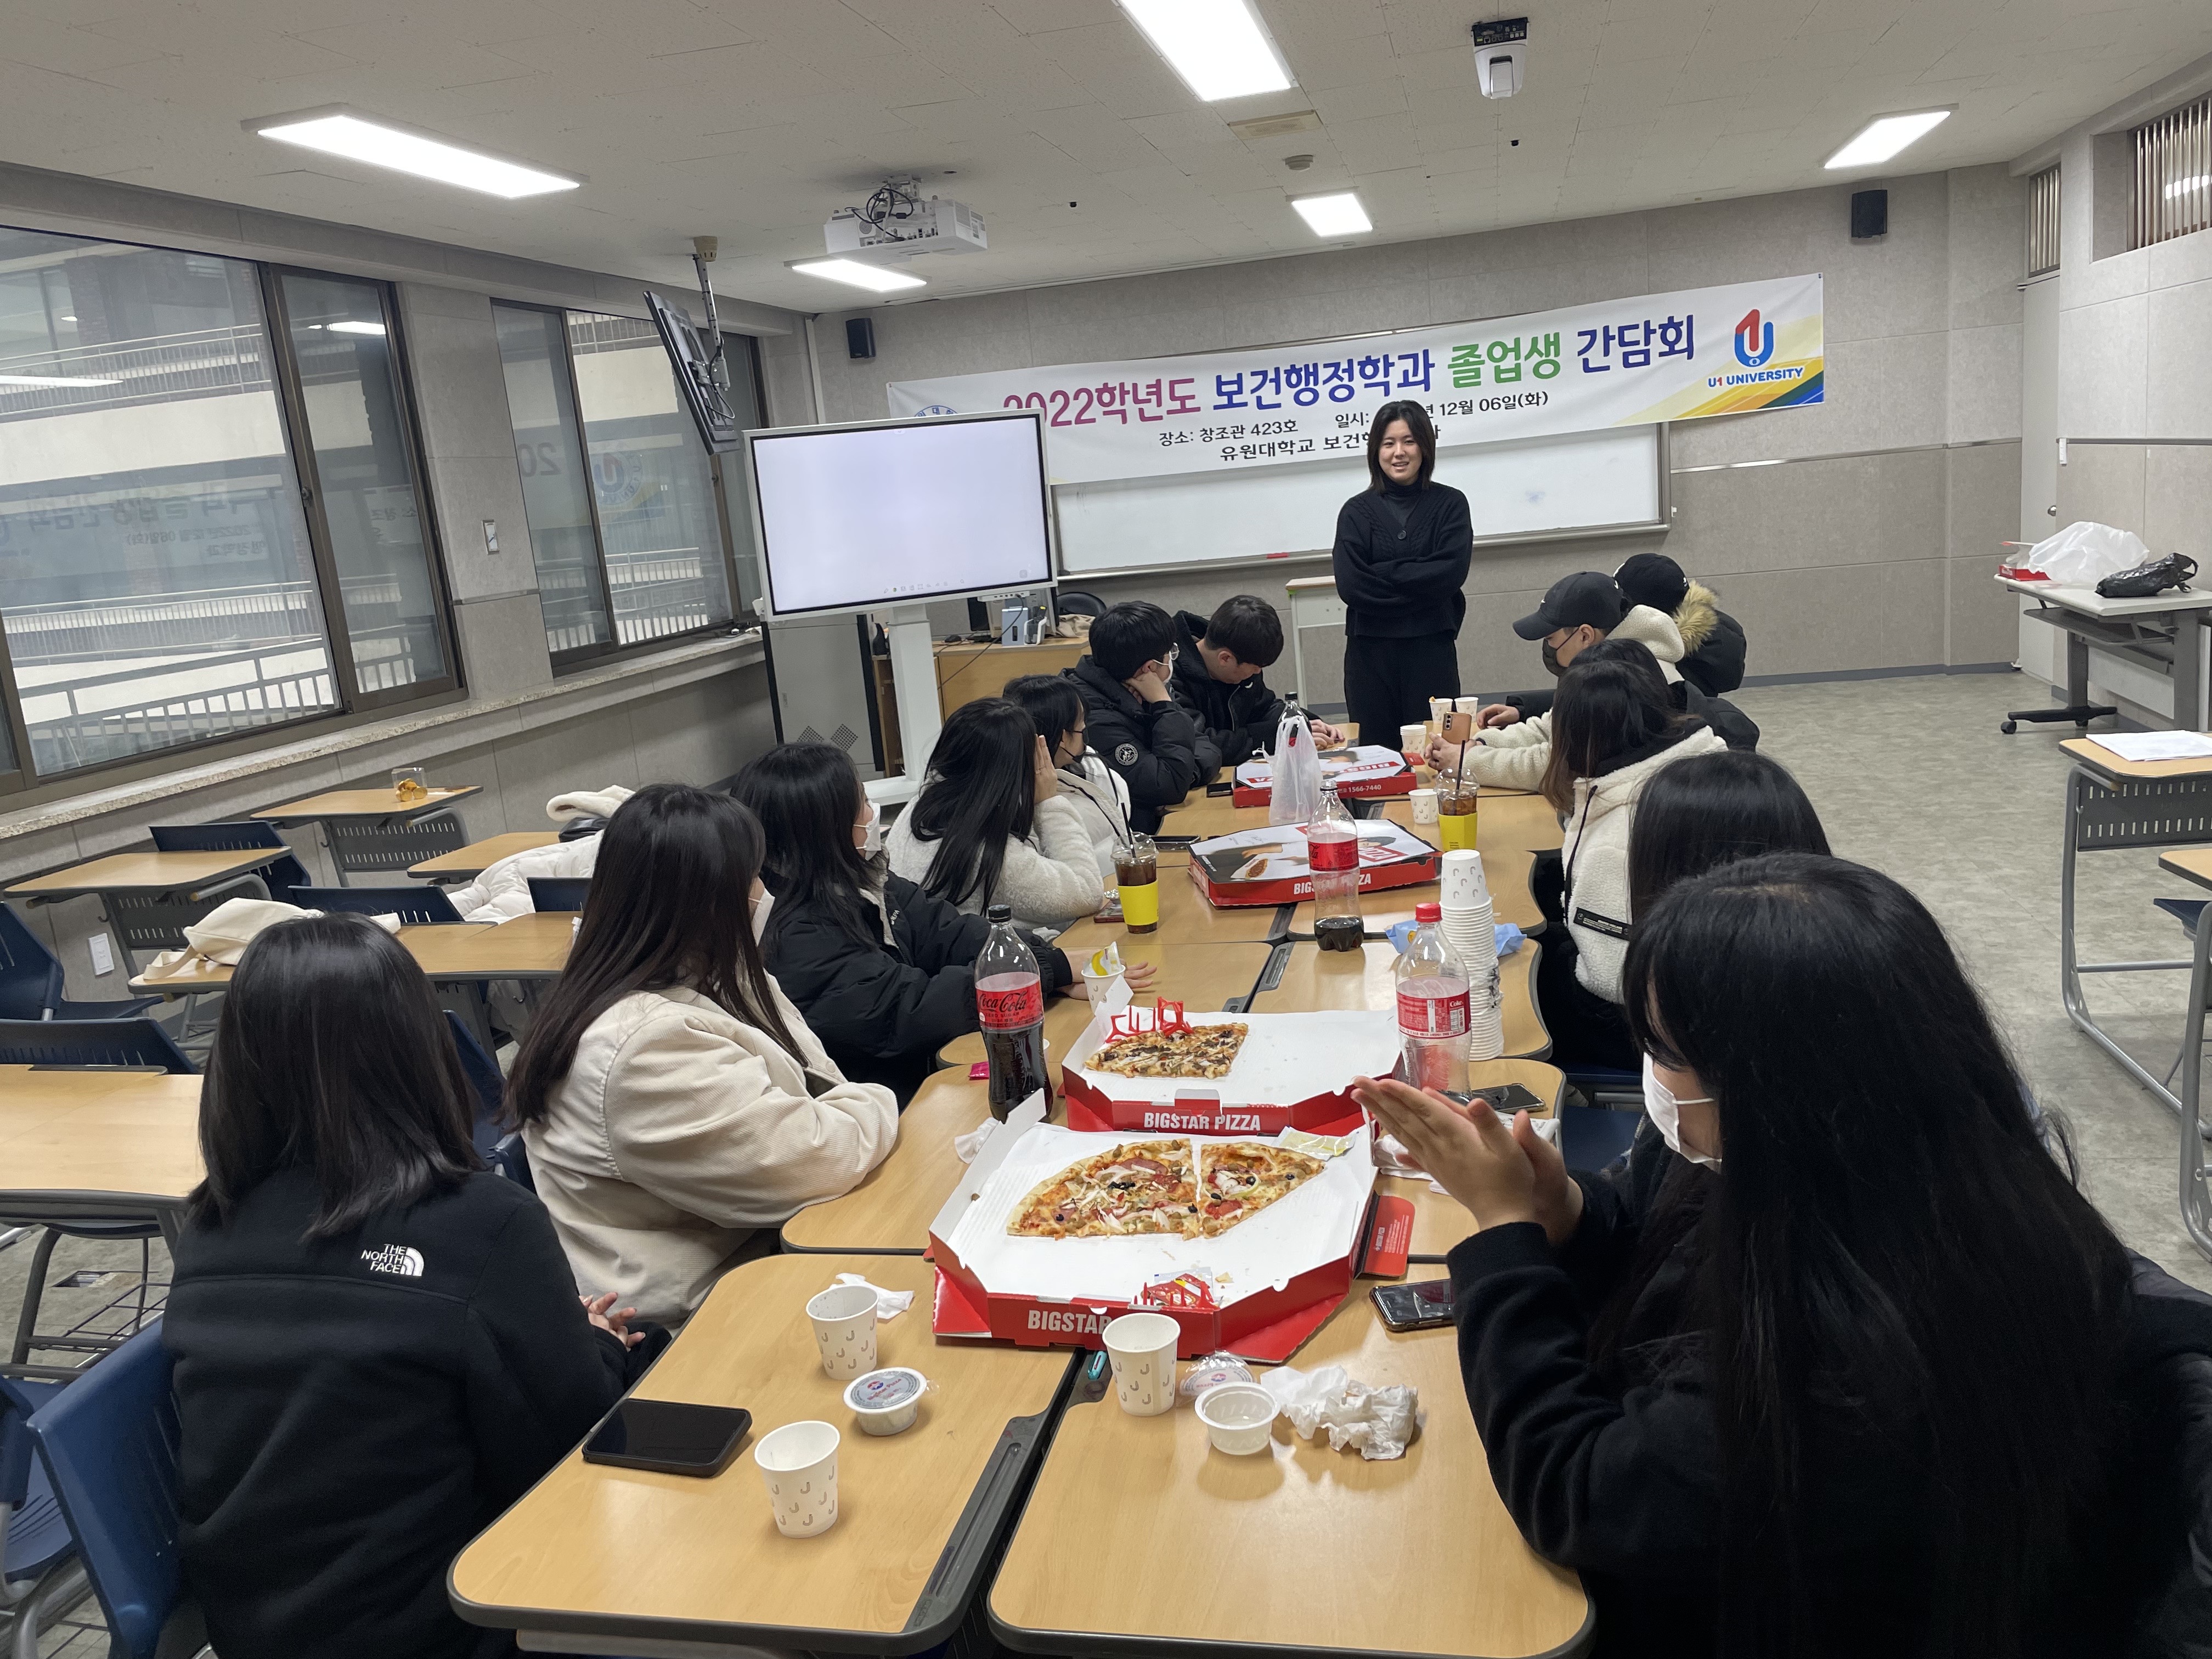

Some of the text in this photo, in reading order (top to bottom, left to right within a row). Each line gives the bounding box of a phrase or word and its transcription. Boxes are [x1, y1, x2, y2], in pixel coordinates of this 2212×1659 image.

[1213, 349, 1435, 410] 보건행정학과
[1448, 332, 1561, 388] 졸업생
[1577, 314, 1694, 373] 간담회
[1708, 368, 1804, 387] U1 UNIVERSITY
[1159, 431, 1193, 447] 장소:
[1200, 424, 1246, 443] 창조관
[1250, 419, 1299, 436] 423호
[1335, 411, 1369, 428] 일시:
[1439, 399, 1474, 416] 12월
[1479, 391, 1549, 412] 06일(화)
[1220, 438, 1316, 461] 유원대학교
[1348, 784, 1381, 793] 1566-7440
[1144, 1111, 1261, 1131] BIGSTAR PIZZA
[360, 1249, 404, 1265] NORTH
[384, 1243, 407, 1255] THE
[370, 1261, 402, 1274] FACE
